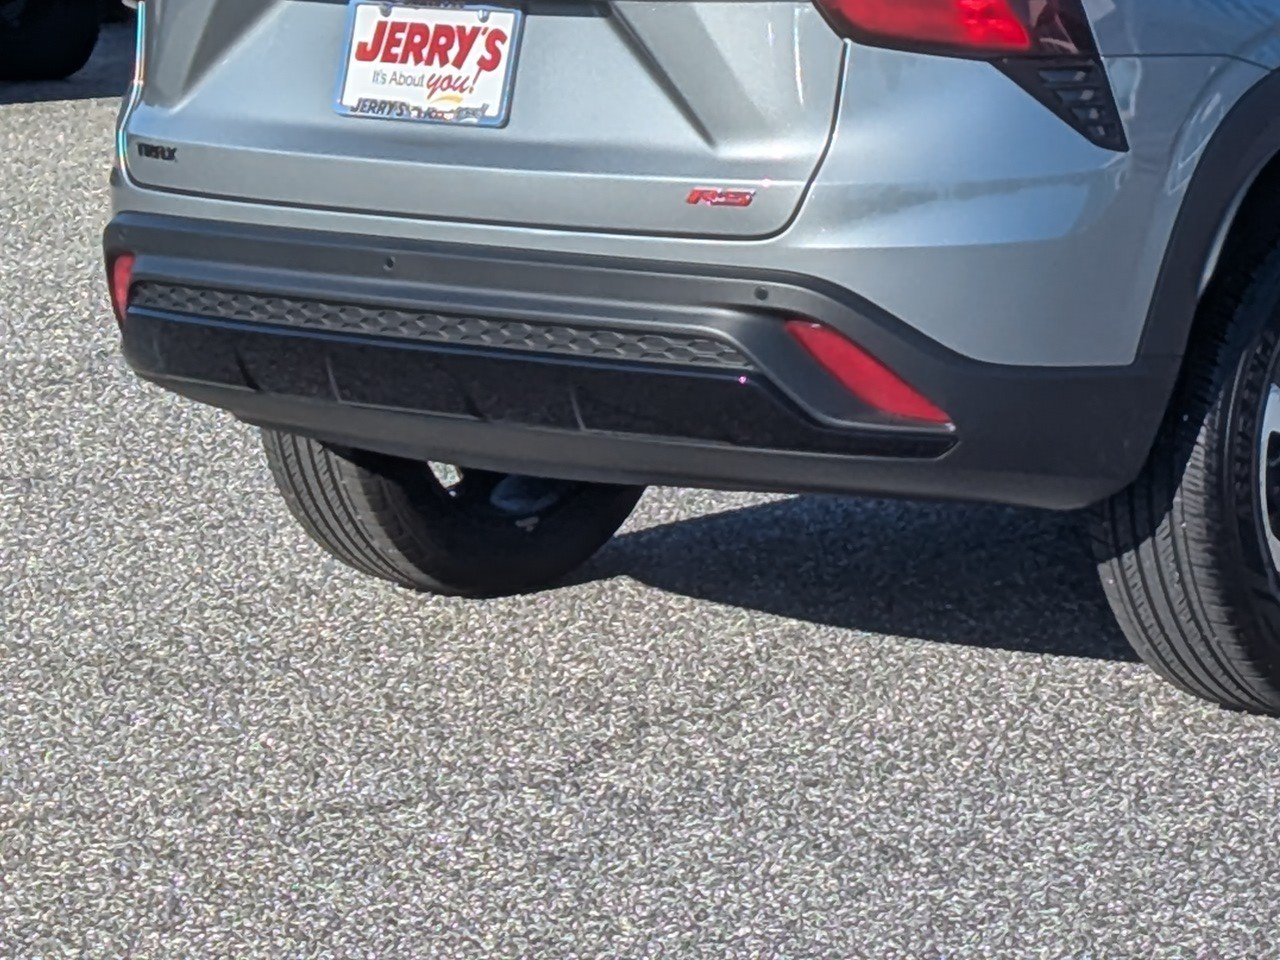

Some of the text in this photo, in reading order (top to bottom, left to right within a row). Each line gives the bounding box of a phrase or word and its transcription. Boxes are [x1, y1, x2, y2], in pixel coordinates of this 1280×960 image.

[355, 20, 508, 72] JERRY'S
[372, 68, 483, 100] It's About you!
[686, 188, 755, 207] RS
